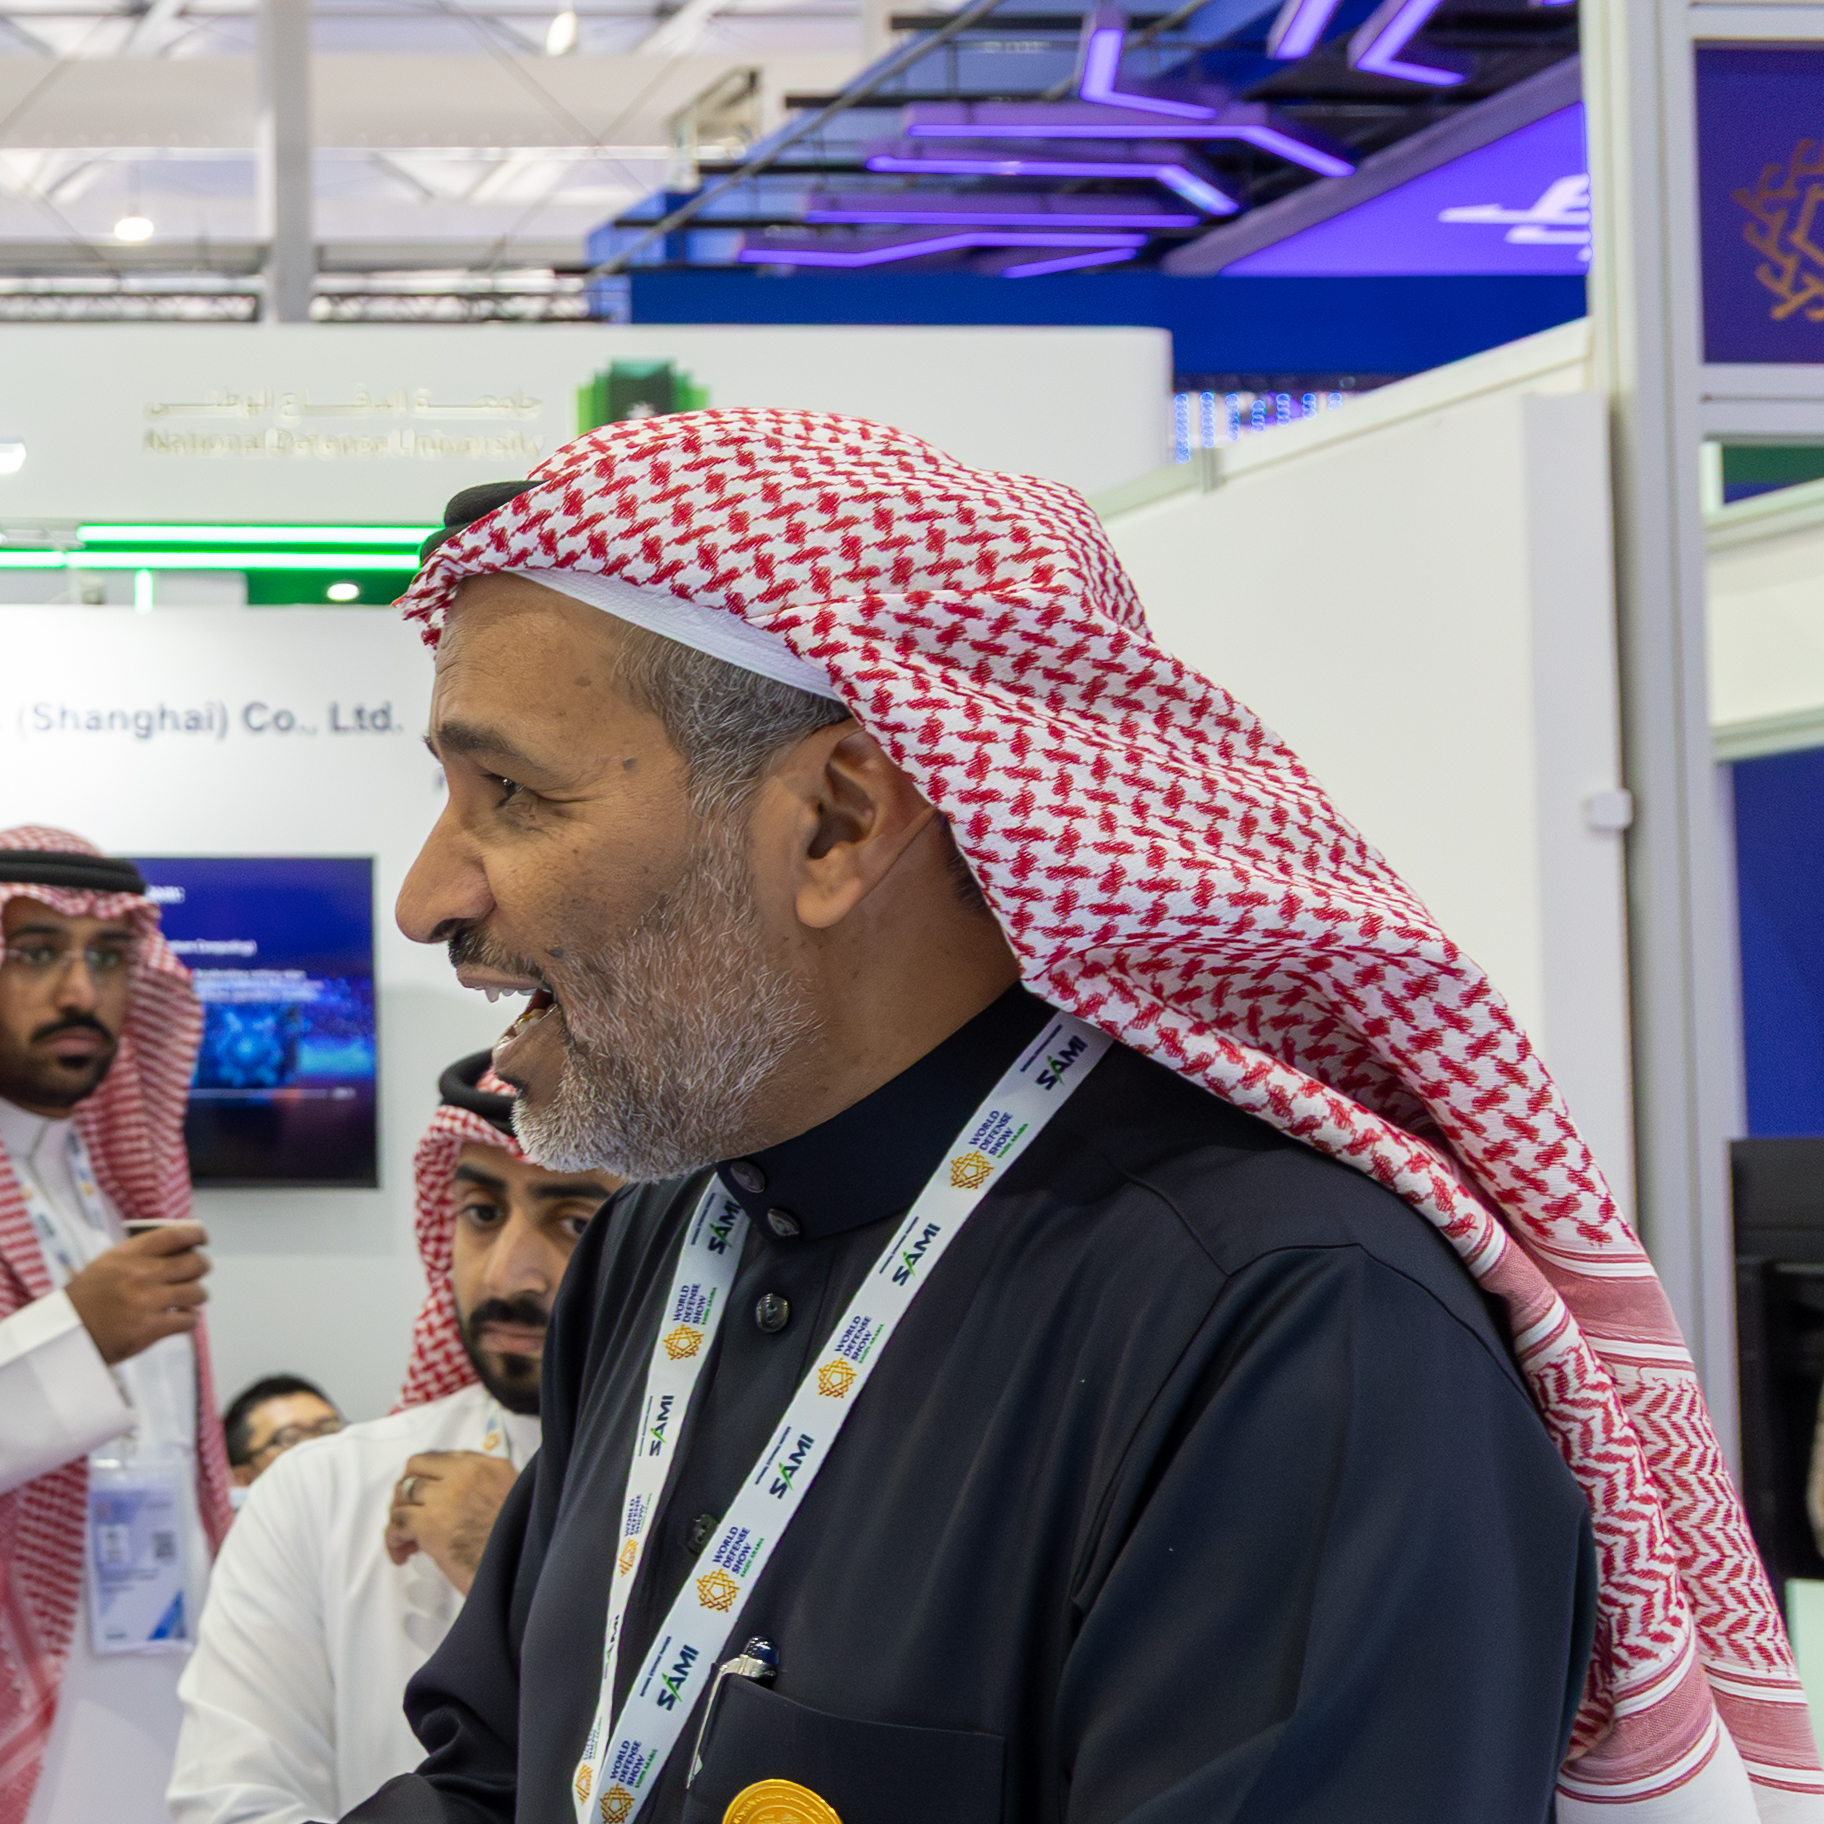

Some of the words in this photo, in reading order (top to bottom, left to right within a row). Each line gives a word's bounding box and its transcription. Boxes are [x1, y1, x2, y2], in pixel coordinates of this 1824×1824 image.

[18, 700, 230, 740] (Shanghai)
[242, 700, 317, 735] Co.,
[329, 700, 405, 733] Ltd.
[1035, 1034, 1088, 1091] SAMI
[968, 1110, 1000, 1146] WORLD
[979, 1112, 1013, 1151] DEFENSE
[988, 1127, 1014, 1156] SHOW
[707, 1199, 743, 1256] SAMI
[892, 1222, 942, 1287] SAMI
[673, 1285, 690, 1322] WORLD
[682, 1283, 701, 1323] DEFENSE
[692, 1295, 707, 1325] SHOW
[834, 1315, 862, 1353] WORLD
[843, 1315, 873, 1357] DEFENSE
[851, 1331, 873, 1362] SHOW
[649, 1394, 675, 1457] SAMI
[769, 1433, 815, 1500] SAMI
[712, 1526, 740, 1564] WORLD
[722, 1526, 751, 1570] DEFENSE
[732, 1542, 754, 1575] SHOW
[656, 1643, 700, 1712] SAMI
[610, 1739, 631, 1780] WORLD
[618, 1740, 643, 1783] DEFENSE
[626, 1754, 647, 1787] SHOW
